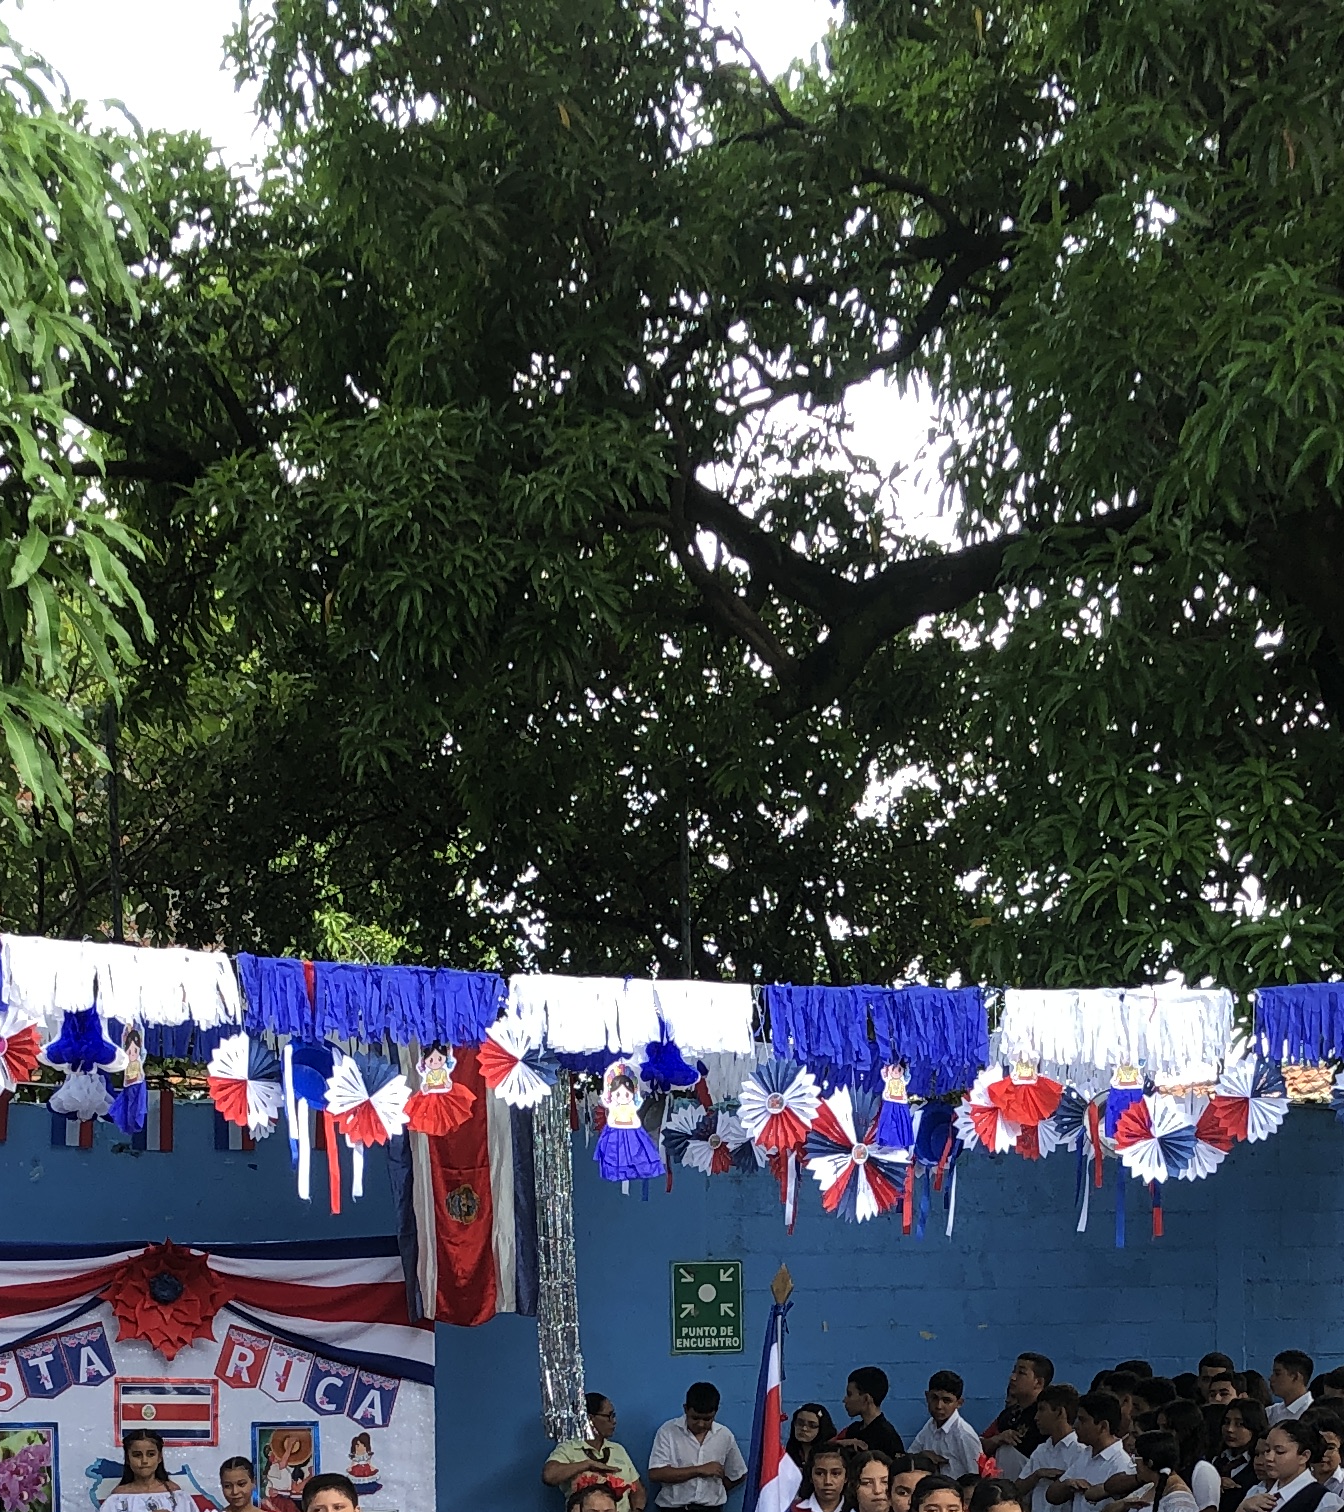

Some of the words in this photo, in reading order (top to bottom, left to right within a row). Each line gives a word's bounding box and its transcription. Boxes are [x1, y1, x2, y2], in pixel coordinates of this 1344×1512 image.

[682, 1327, 717, 1337] PUNTO
[720, 1326, 733, 1336] DE
[676, 1337, 739, 1348] ENCUENTRO
[224, 1348, 386, 1426] RICA
